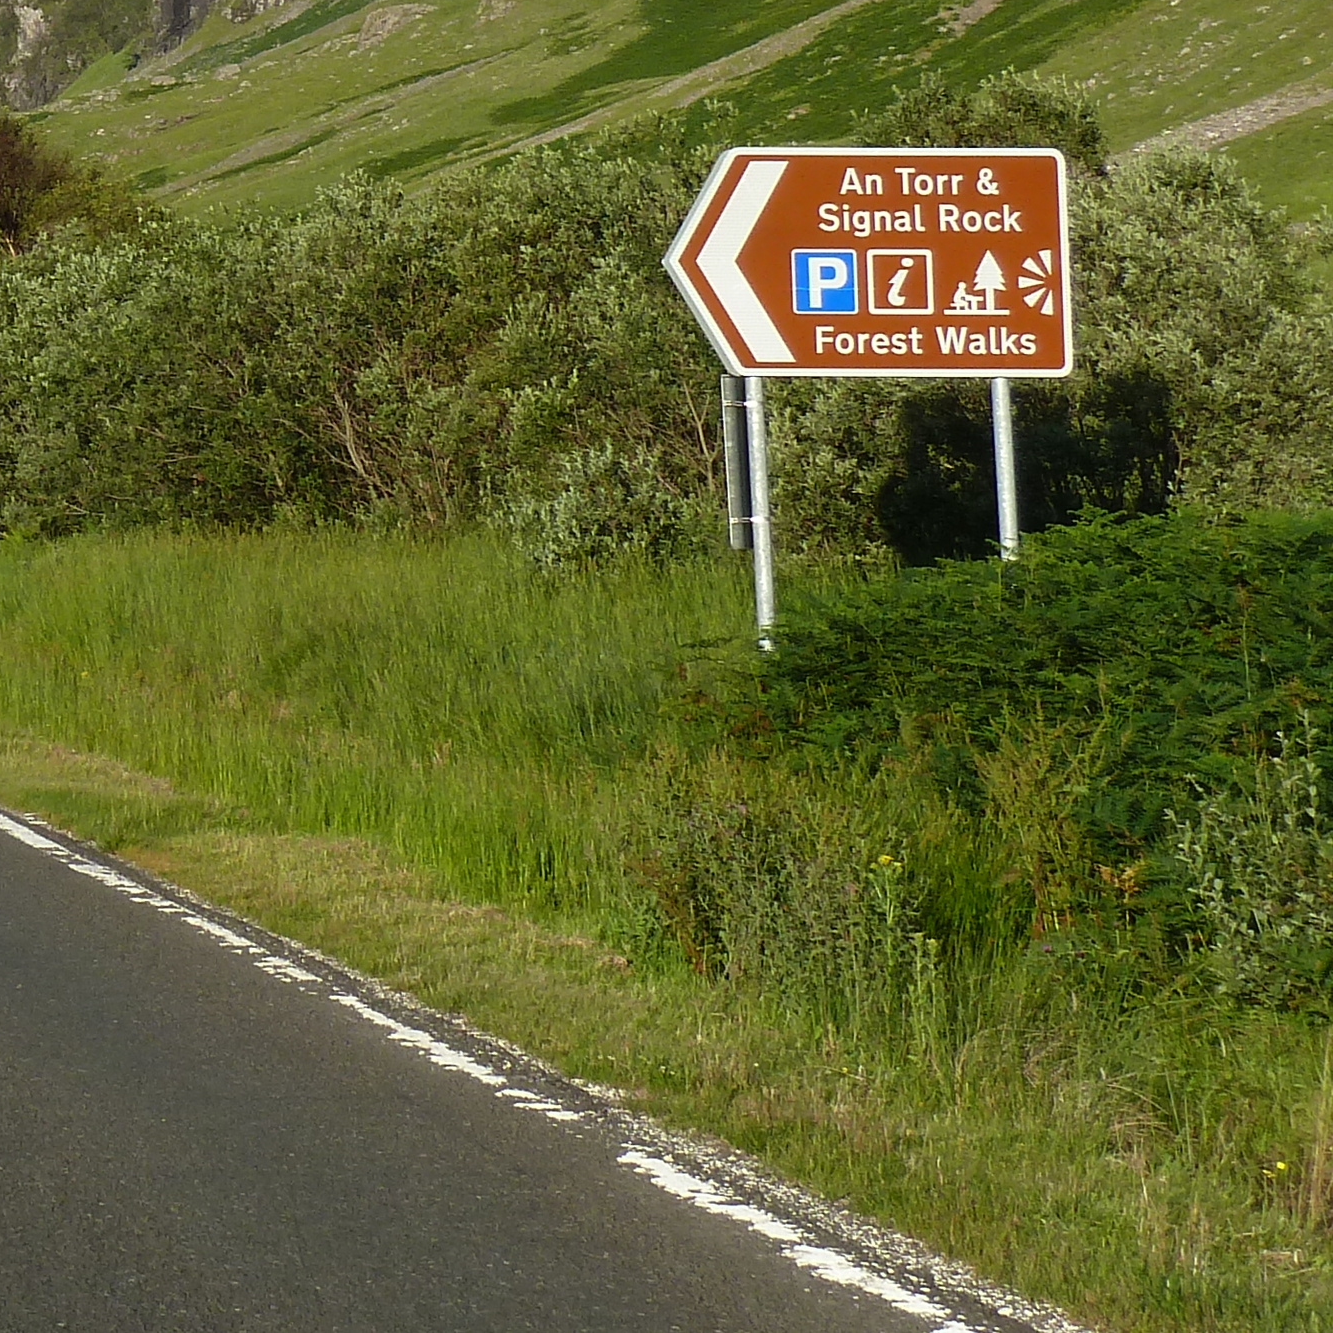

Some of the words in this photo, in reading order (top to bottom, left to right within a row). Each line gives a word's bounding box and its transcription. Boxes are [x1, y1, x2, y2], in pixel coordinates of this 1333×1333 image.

[840, 167, 883, 195] An
[895, 167, 964, 195] Torr
[976, 168, 1000, 196] &
[818, 203, 926, 237] Signal
[939, 204, 1023, 233] Rock
[808, 256, 849, 308] P
[815, 326, 923, 355] Forest
[935, 326, 1037, 356] Walks
